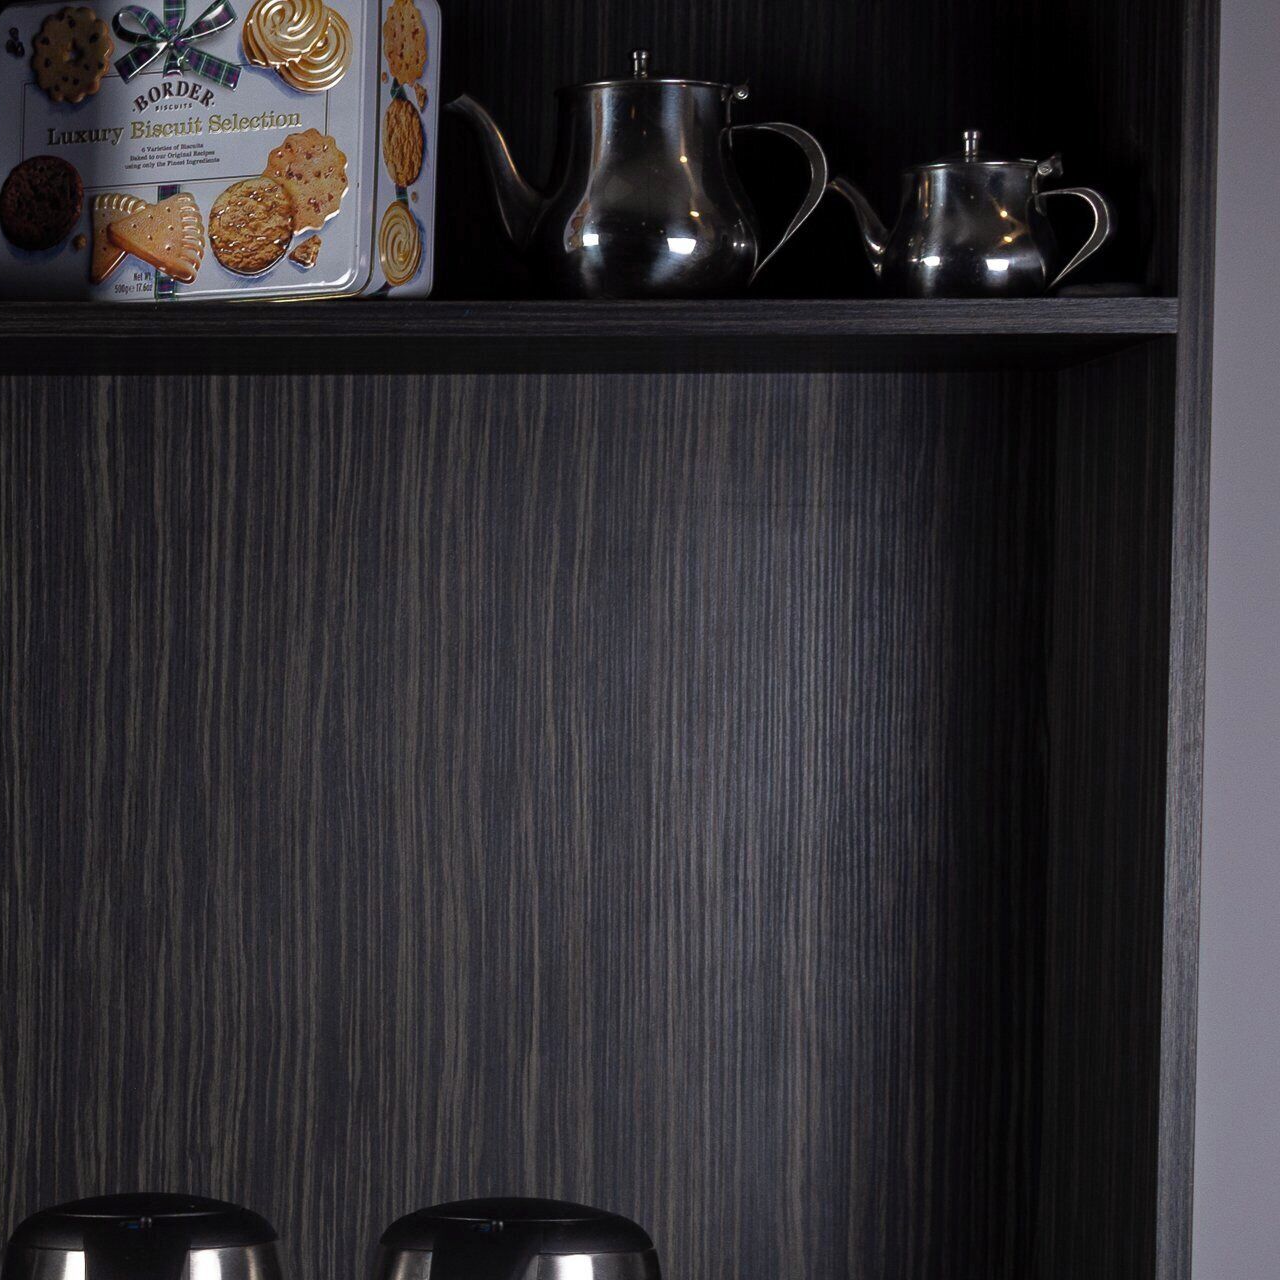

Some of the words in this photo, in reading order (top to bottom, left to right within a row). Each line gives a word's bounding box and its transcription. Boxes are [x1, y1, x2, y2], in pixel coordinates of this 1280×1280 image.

[133, 80, 214, 113] BORDER
[155, 102, 193, 112] BISCUITS
[47, 127, 124, 146] Luxury
[130, 117, 203, 140] Biscuit
[208, 110, 303, 134] Selection
[167, 152, 192, 160] Original
